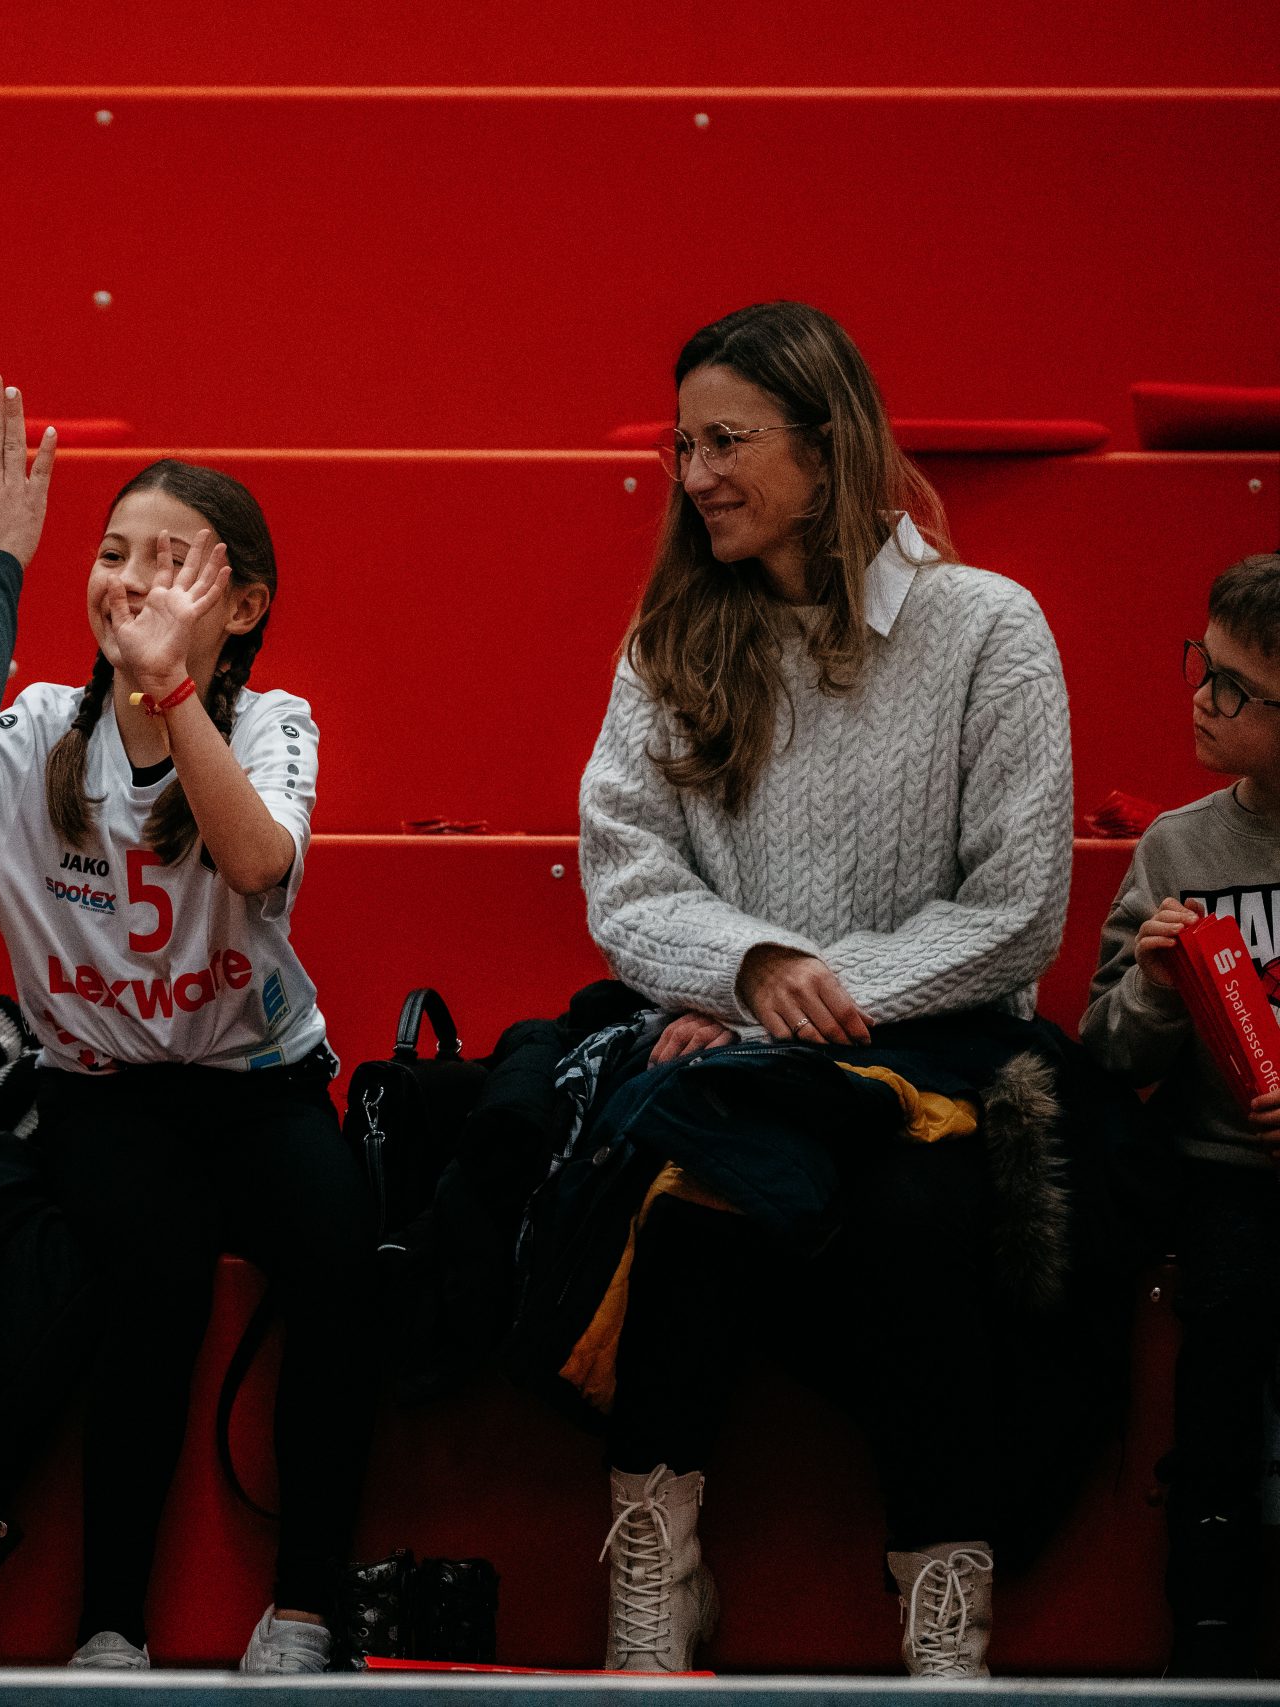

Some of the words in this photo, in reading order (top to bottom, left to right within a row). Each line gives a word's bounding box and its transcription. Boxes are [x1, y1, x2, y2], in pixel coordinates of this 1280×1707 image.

[60, 852, 110, 877] JAKO
[126, 849, 173, 953] 5
[47, 948, 253, 1020] Lexware
[1224, 979, 1264, 1059] Sparkasse
